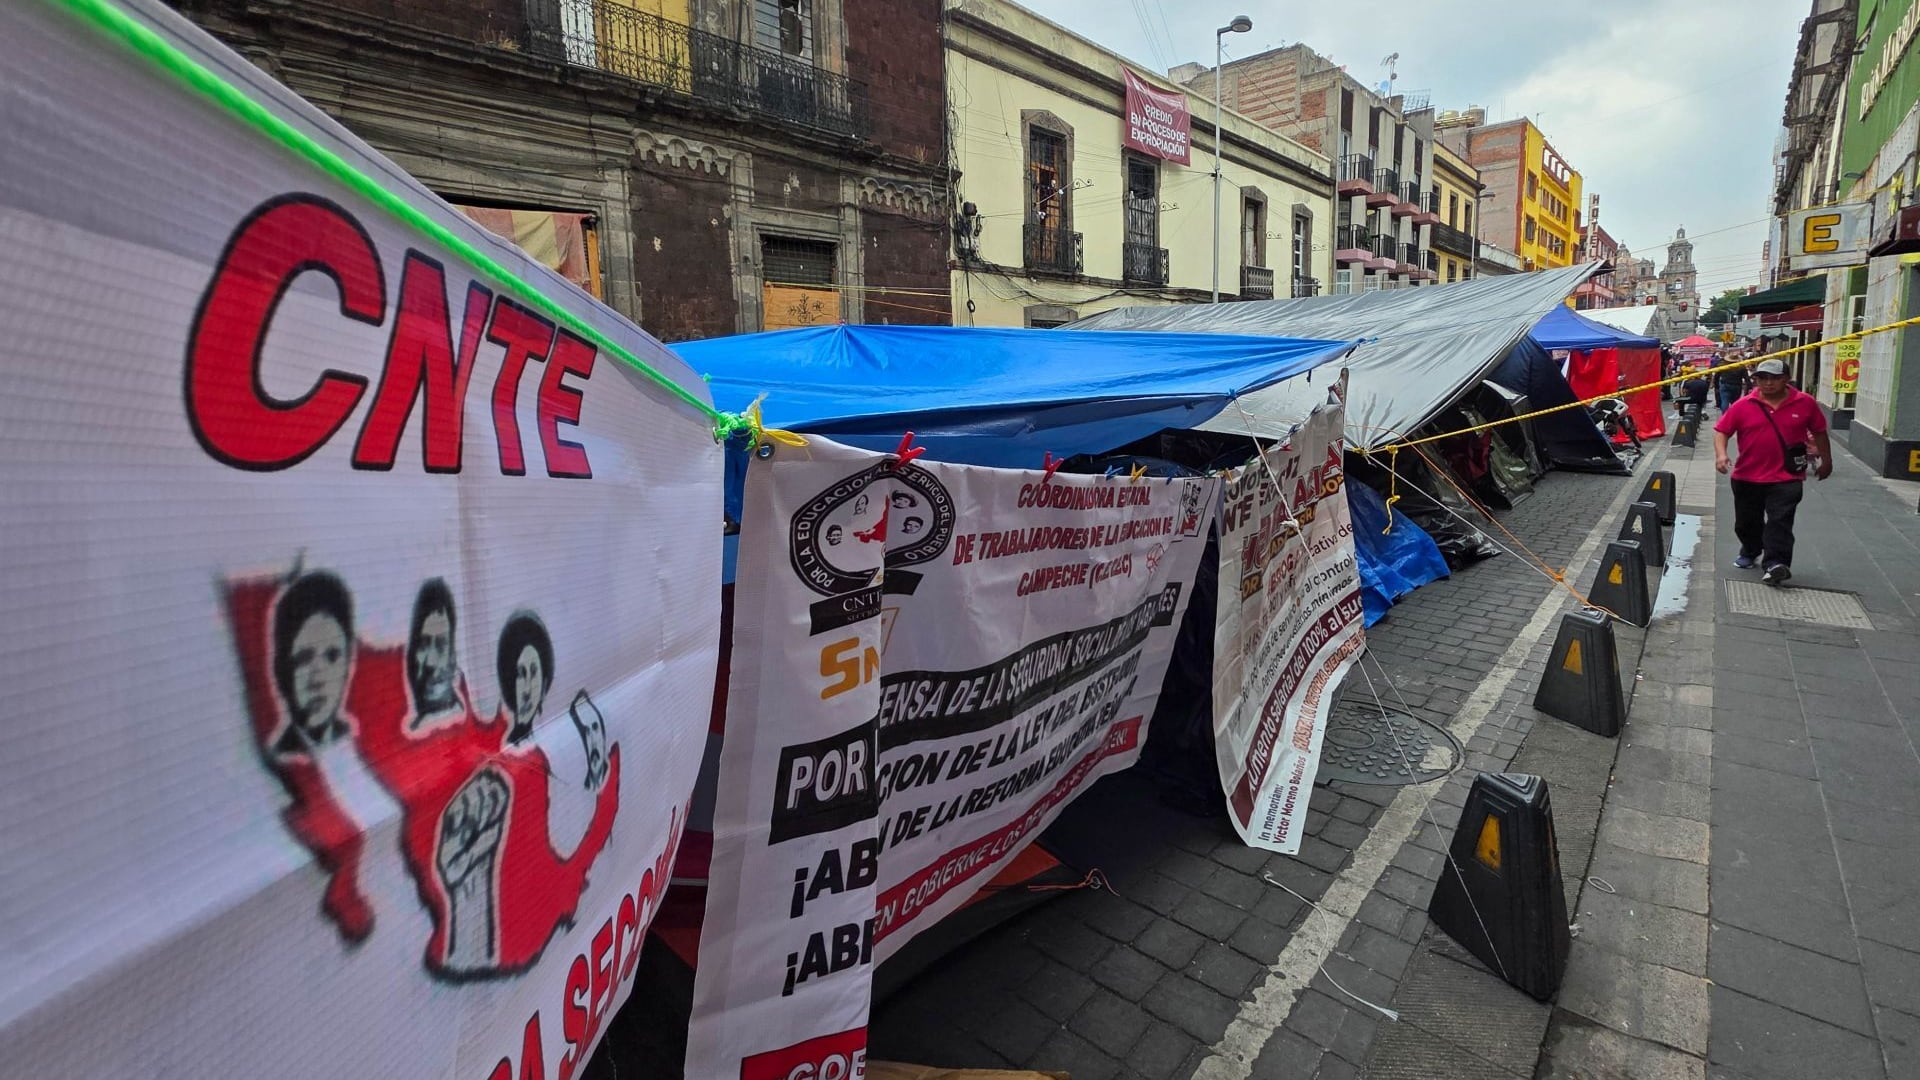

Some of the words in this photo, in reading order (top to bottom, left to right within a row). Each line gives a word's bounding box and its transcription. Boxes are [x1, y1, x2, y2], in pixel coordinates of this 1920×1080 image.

[1131, 112, 1141, 127] EN
[1142, 118, 1176, 140] PROCESO
[1176, 131, 1186, 144] DE
[1145, 105, 1172, 125] PREDIO
[1132, 128, 1184, 156] EXPROPIACIÓN
[1589, 194, 1600, 258] HOTEL
[1803, 213, 1841, 254] E
[185, 191, 598, 479] CNTE
[900, 466, 945, 504] SERVICIO
[939, 504, 951, 526] DEL
[799, 548, 815, 567] LA
[904, 528, 949, 560] PUEBLO
[953, 533, 977, 566] DE
[978, 527, 1090, 561] TRABAJADORES
[1104, 524, 1121, 546] LA
[810, 566, 835, 588] POR
[1017, 563, 1090, 597] CAMPECHE
[1313, 553, 1354, 586] control
[945, 679, 985, 717] DE
[983, 669, 1010, 710] LA
[1007, 637, 1073, 696] SEGURIDAD
[1270, 672, 1296, 725] salarial
[1291, 651, 1309, 680] del
[1301, 622, 1329, 661] 100%
[1326, 606, 1343, 630] al
[945, 738, 993, 781] DE
[987, 725, 1021, 769] LA
[1021, 706, 1055, 754] LEY
[787, 739, 868, 811] POR
[1281, 783, 1300, 818] Moreno
[890, 805, 932, 849] DE
[927, 795, 964, 832] LA
[1258, 827, 1272, 842] In
